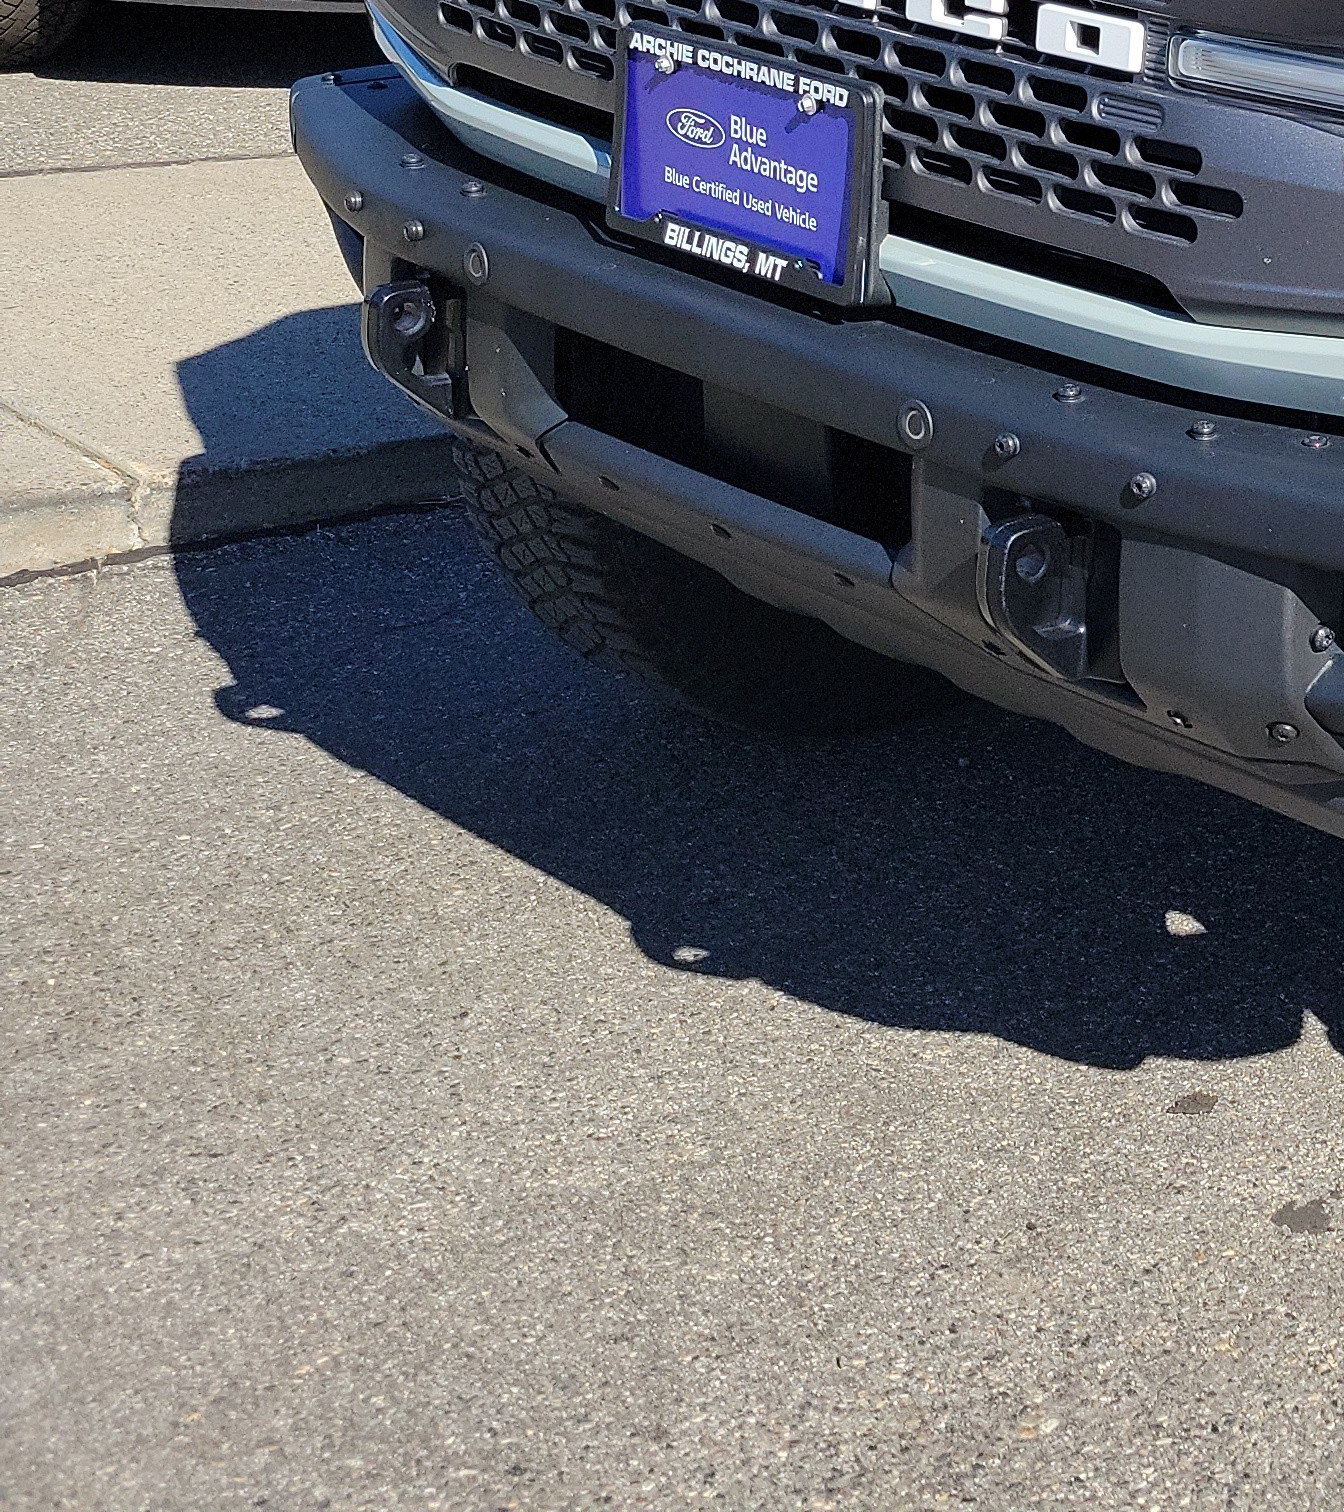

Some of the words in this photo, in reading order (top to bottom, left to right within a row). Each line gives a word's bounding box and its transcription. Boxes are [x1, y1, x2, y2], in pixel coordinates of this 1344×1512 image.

[629, 32, 694, 64] ARCHIE
[697, 49, 795, 93] COCHRANE
[798, 78, 849, 108] FORD
[676, 111, 715, 145] Ford
[729, 115, 767, 148] Blue
[728, 143, 819, 194] Advantage
[664, 166, 690, 190] Blue
[692, 176, 740, 206] Certified
[743, 193, 772, 217] Used
[775, 203, 818, 232] Vehicle
[663, 223, 750, 273] BILLINGS,
[755, 252, 789, 282] MT
